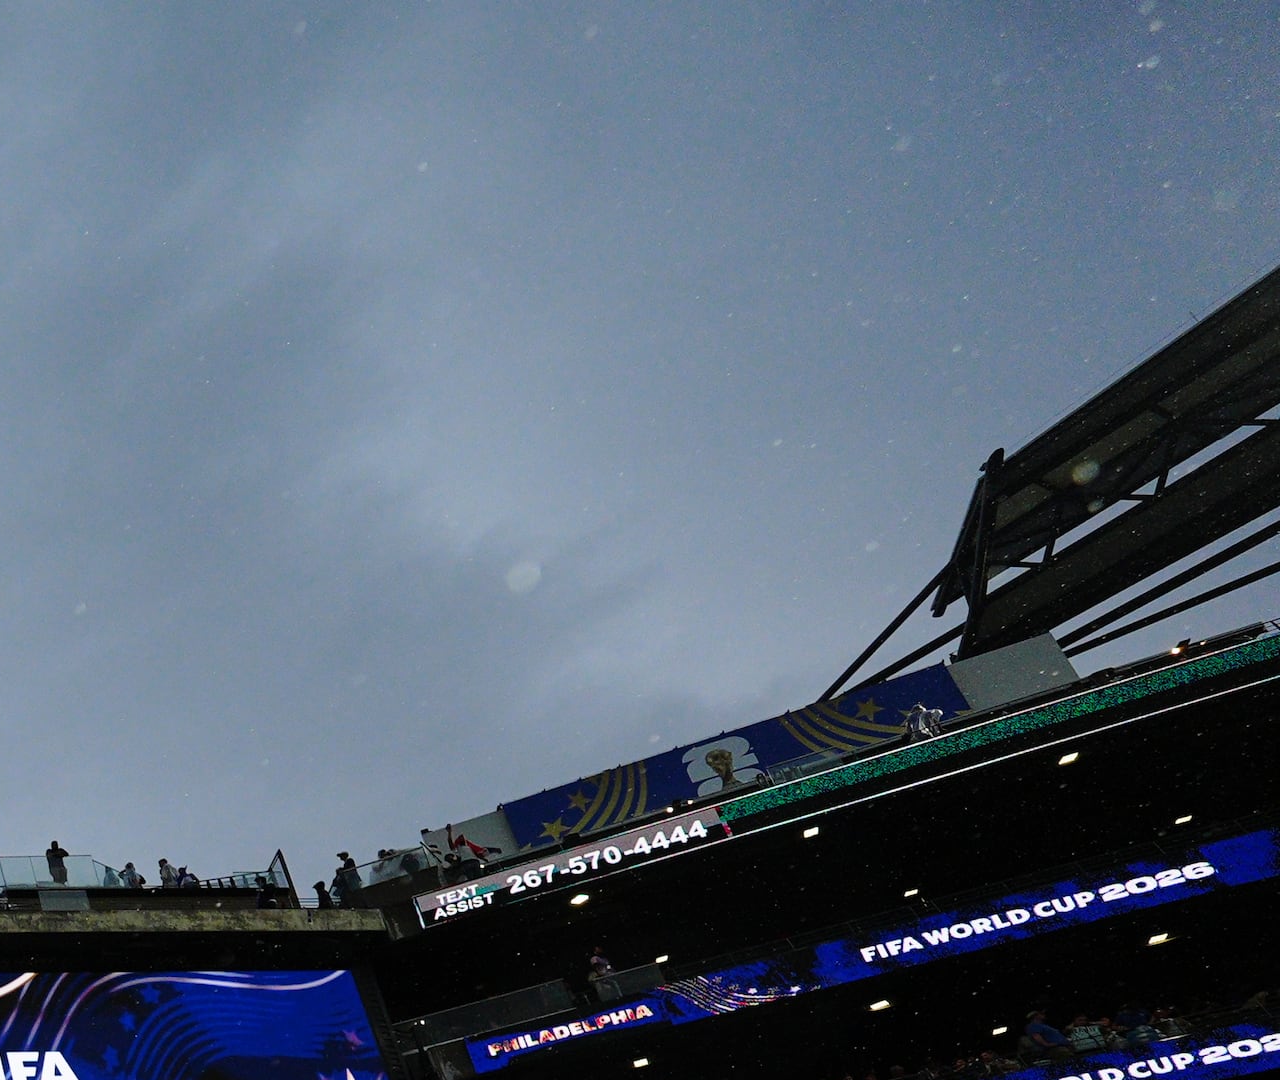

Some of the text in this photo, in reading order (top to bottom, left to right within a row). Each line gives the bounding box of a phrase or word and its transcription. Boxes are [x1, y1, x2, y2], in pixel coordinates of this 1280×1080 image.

[506, 819, 708, 894] 267-570-4444
[433, 892, 495, 921] ASSIST
[436, 884, 480, 906] TEXT
[860, 861, 1215, 963] FIFA WORLD CUP 2026
[487, 1004, 653, 1057] PHILADELPHIA
[1127, 1052, 1194, 1079] CUP
